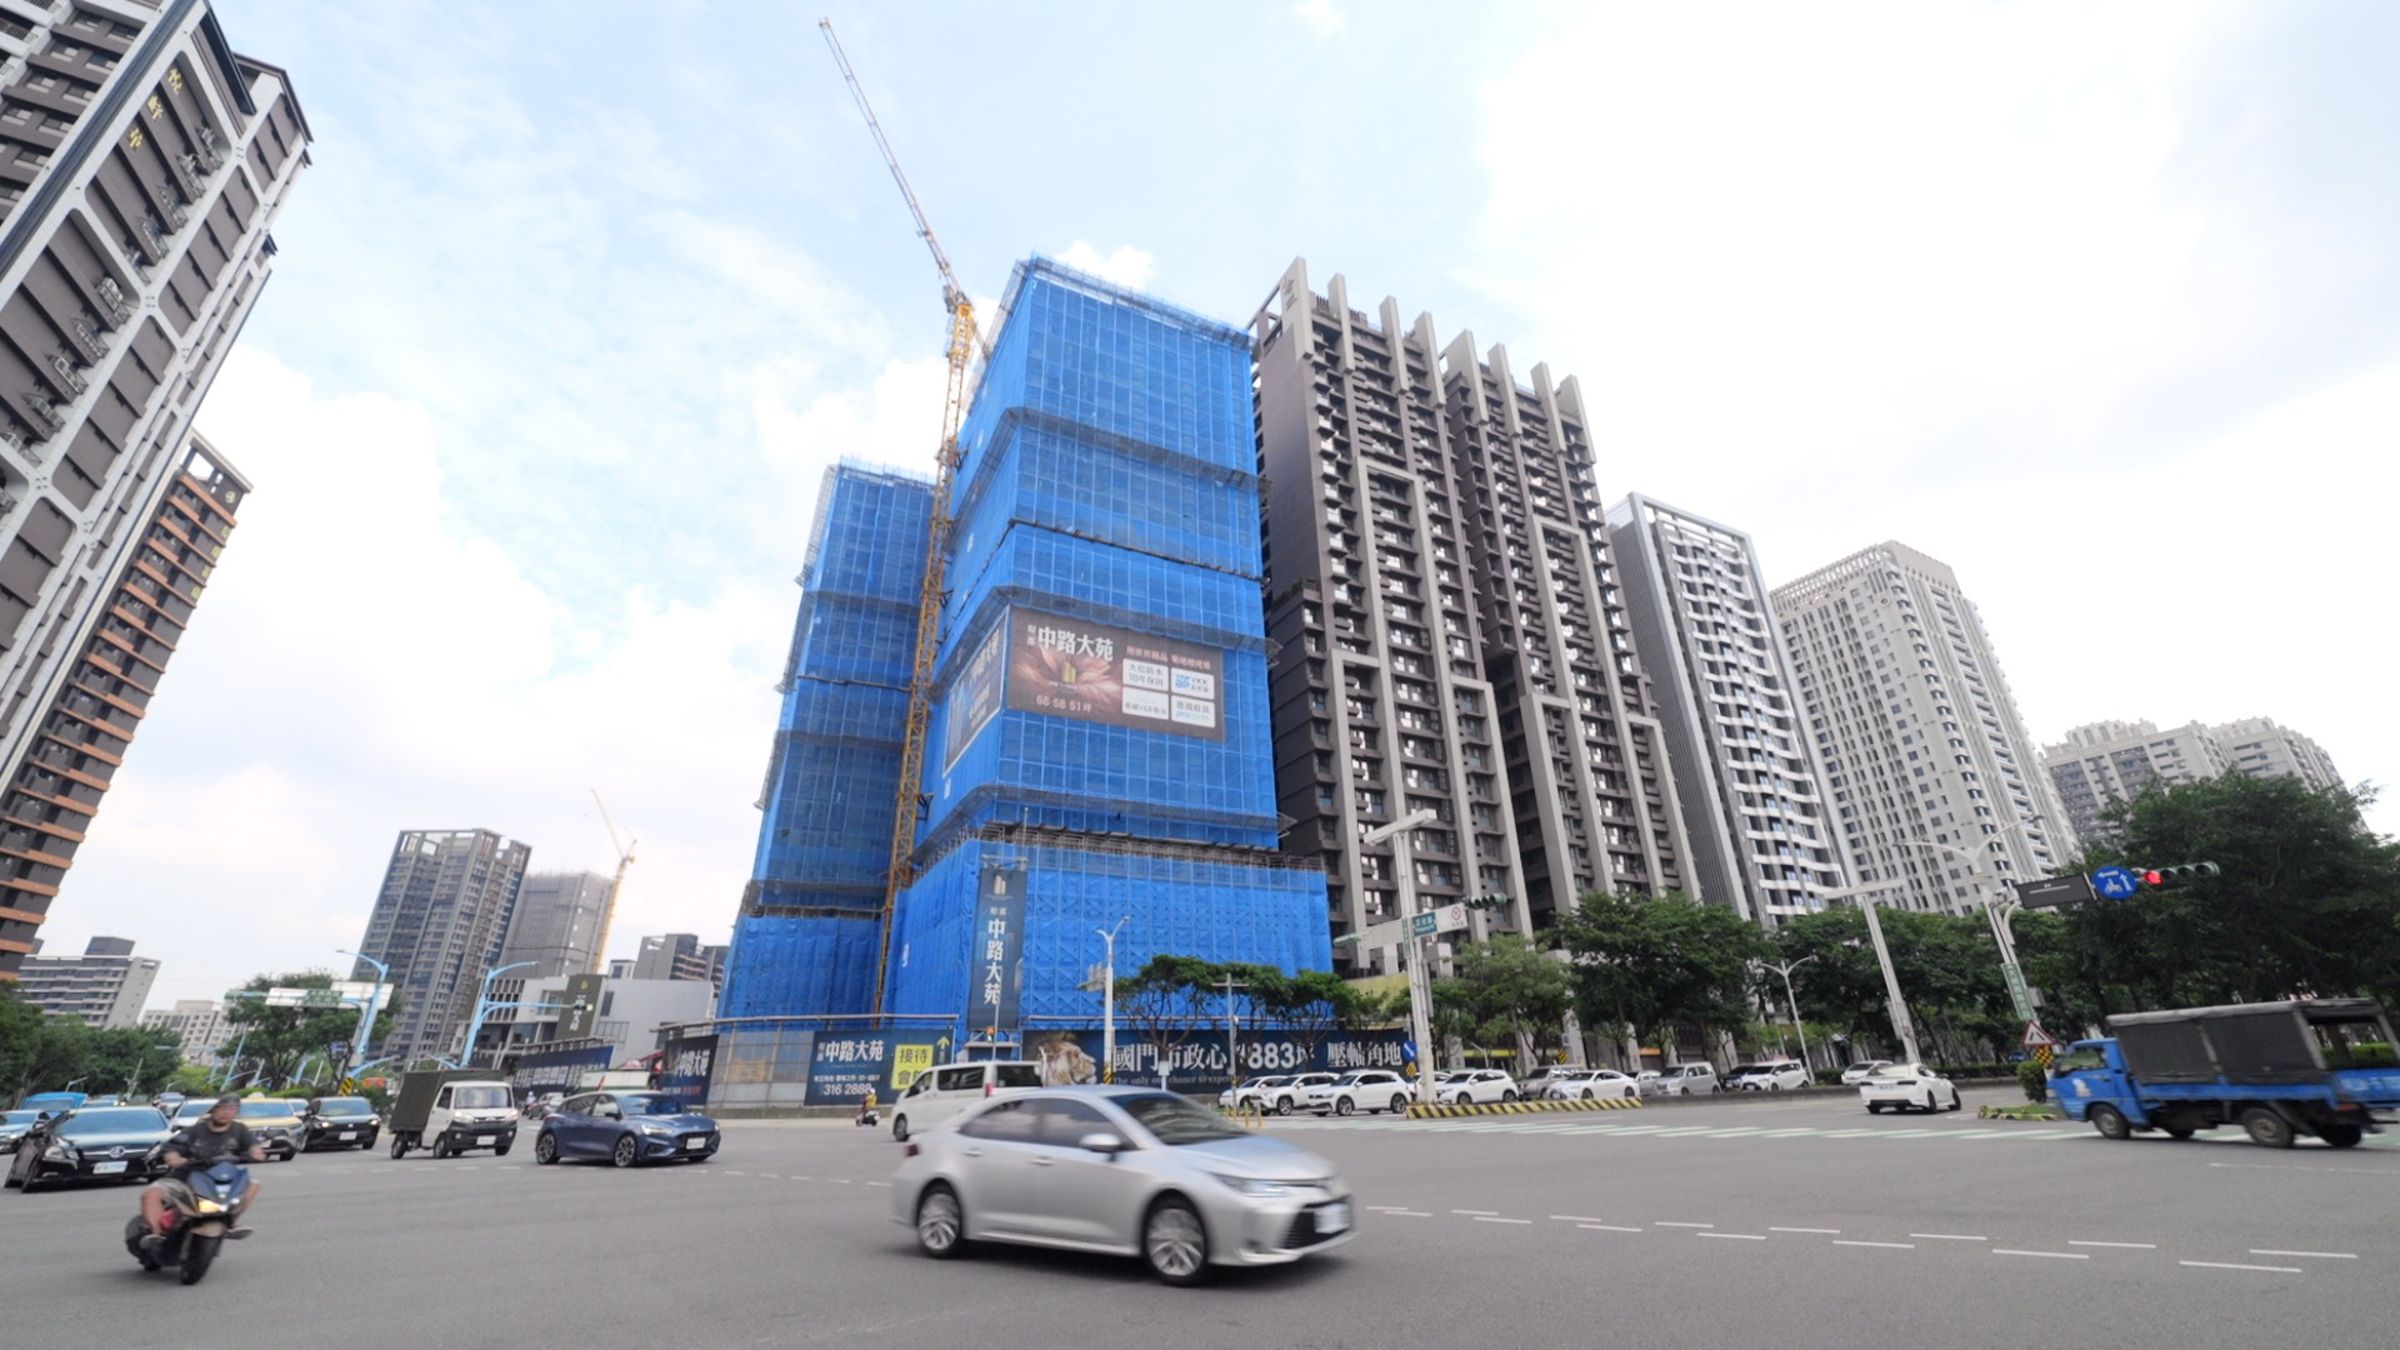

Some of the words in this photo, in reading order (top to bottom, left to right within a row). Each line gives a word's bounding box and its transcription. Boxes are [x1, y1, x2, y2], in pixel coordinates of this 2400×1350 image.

[1038, 626, 1113, 662] 中路大苑
[984, 918, 1006, 1005] 中路大苑
[825, 1040, 884, 1063] 中路大苑
[899, 1047, 928, 1064] 接待
